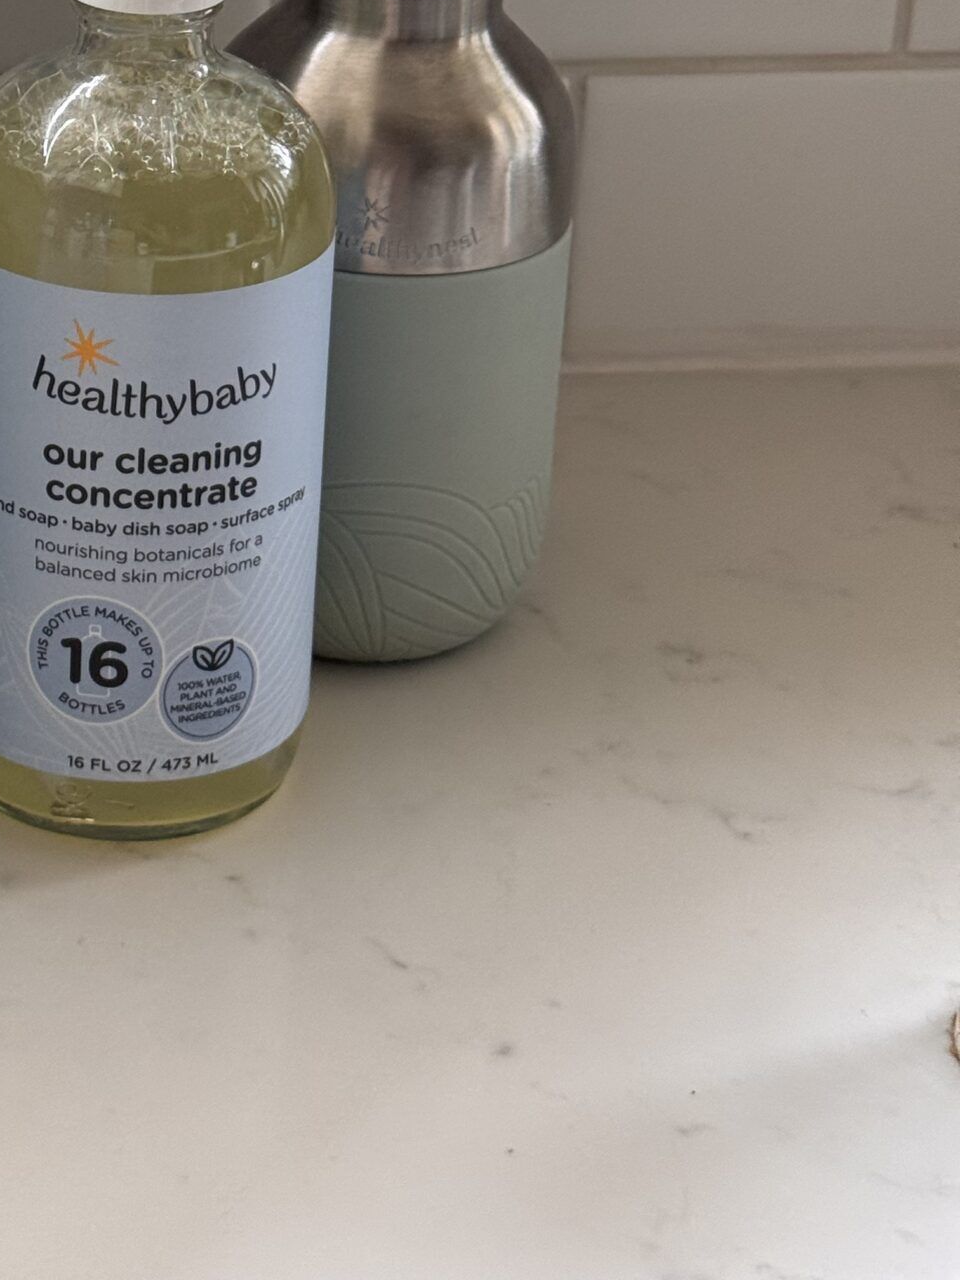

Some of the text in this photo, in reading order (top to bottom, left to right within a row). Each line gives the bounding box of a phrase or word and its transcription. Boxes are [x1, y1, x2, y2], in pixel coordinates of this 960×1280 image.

[32, 354, 277, 424] healthybaby
[43, 438, 262, 475] our cleaning
[46, 476, 258, 510] concentrate
[18, 506, 59, 528] soap
[72, 516, 117, 537] baby
[122, 520, 160, 536] dish
[165, 521, 208, 535] soap
[220, 504, 275, 529] surface
[277, 486, 306, 512] spray
[34, 534, 263, 564] nourishing botanicals for a
[35, 555, 262, 583] balanced skin microbiome
[36, 605, 155, 679] THIS BOTTLE MAKES UP TO
[60, 637, 129, 688] 16
[177, 680, 204, 692] 100%
[179, 683, 238, 702] PLANT AND
[58, 691, 126, 716] BOTTLES
[169, 690, 247, 713] MINERAL-BASED
[177, 703, 242, 724] INGREDIENTS
[67, 753, 219, 774] 16 FL OZ / 473 ML
